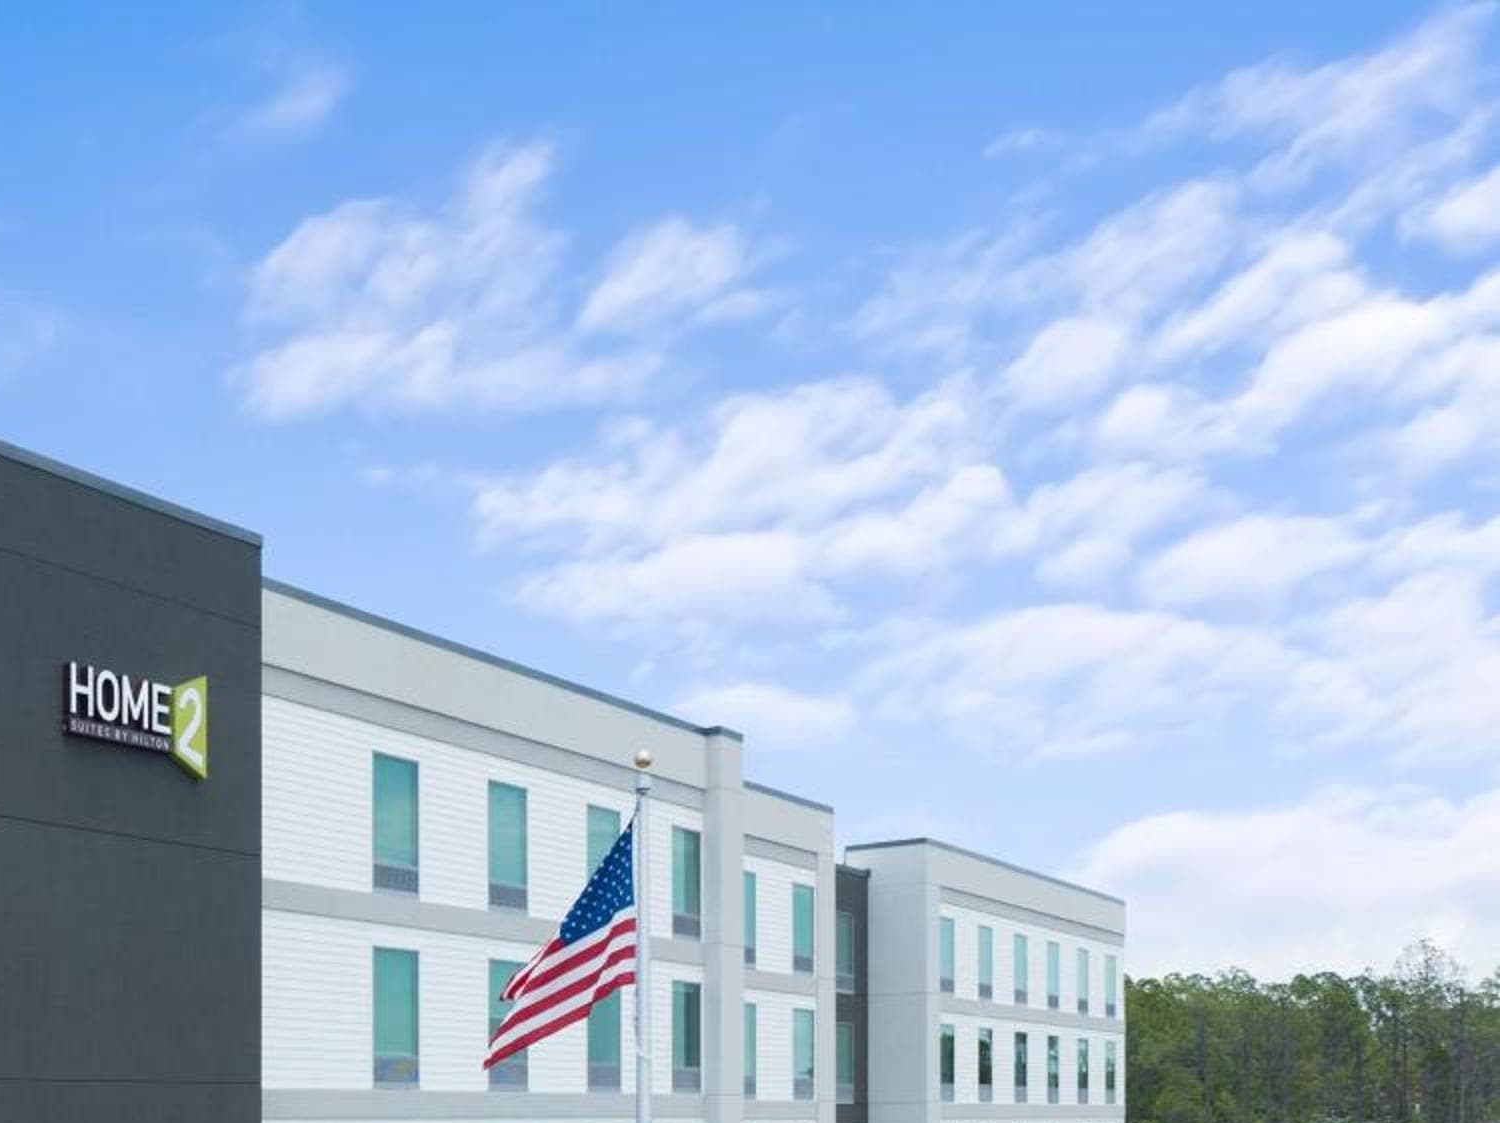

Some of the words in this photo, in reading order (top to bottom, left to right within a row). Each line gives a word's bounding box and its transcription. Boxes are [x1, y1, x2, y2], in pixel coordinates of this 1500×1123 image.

[70, 661, 173, 735] HOME
[178, 687, 203, 768] 2
[70, 719, 109, 735] SUITES
[114, 728, 129, 741] BY
[131, 732, 171, 751] HILTON
